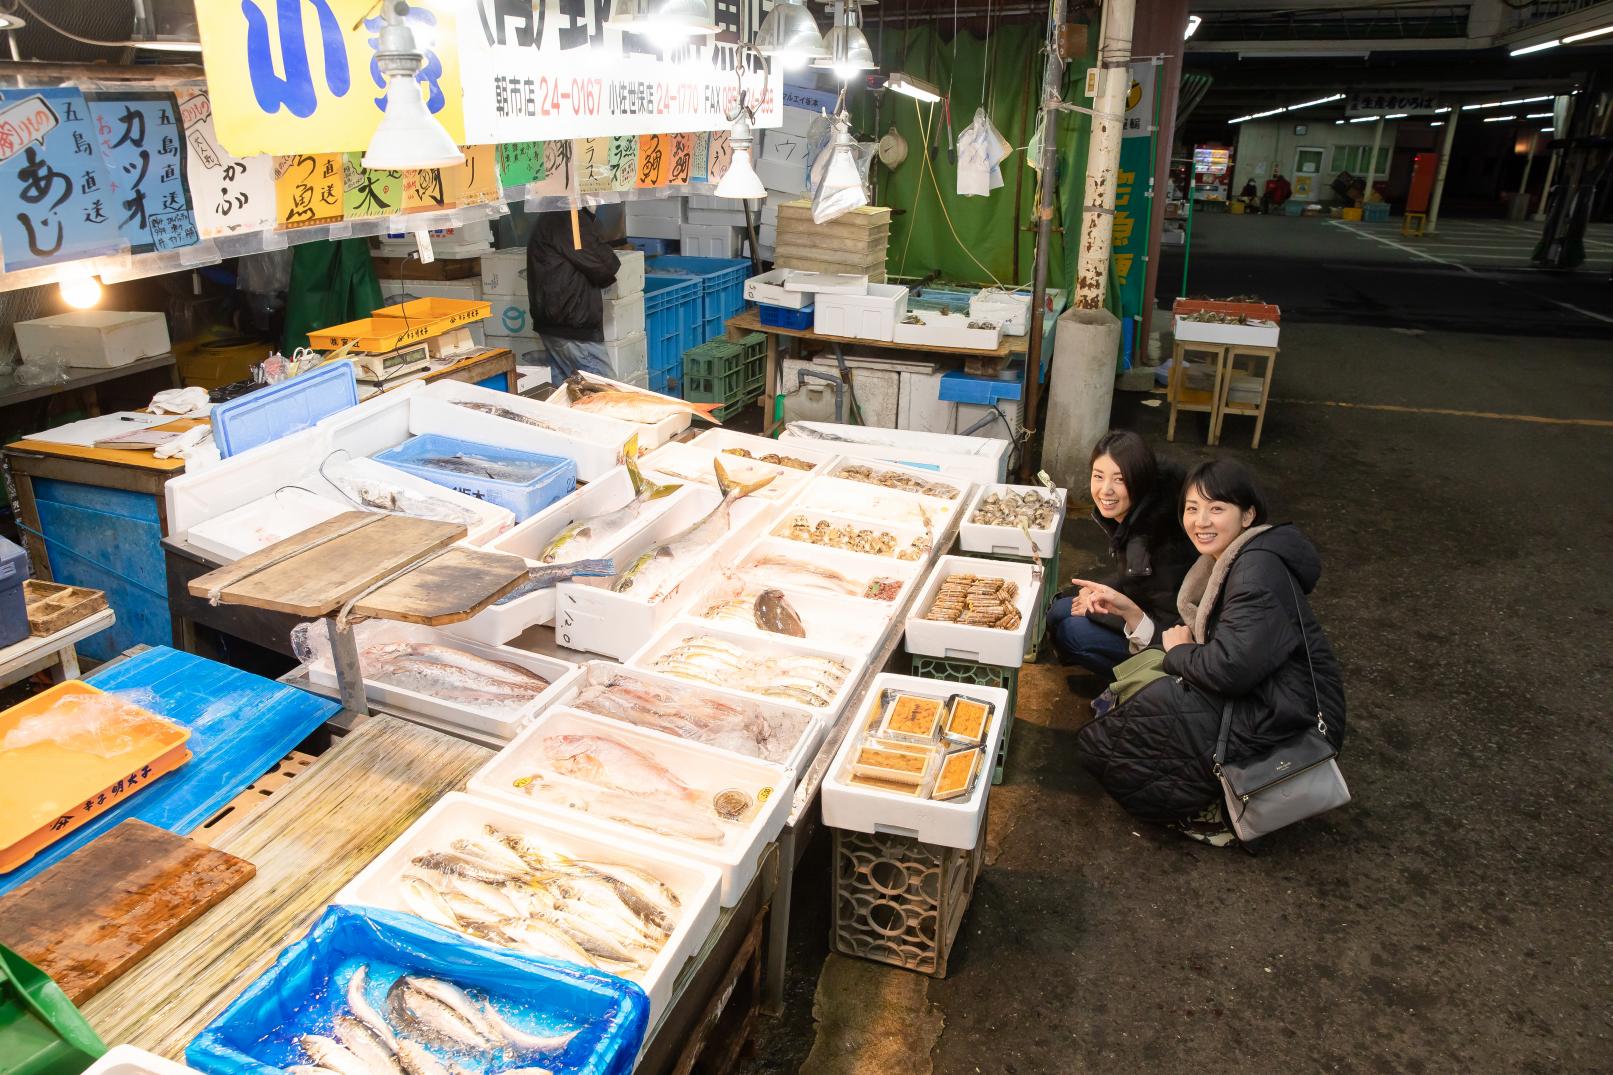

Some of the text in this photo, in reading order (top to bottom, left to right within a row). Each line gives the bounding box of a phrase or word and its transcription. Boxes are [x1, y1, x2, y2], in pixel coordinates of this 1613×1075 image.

[495, 74, 535, 117] 朝市店
[540, 76, 602, 116] 24-0167
[609, 79, 653, 115] 小佐世保店
[704, 84, 721, 114] FAX
[17, 146, 73, 257] あじ
[63, 102, 109, 224] 五島直送
[112, 105, 150, 230] カツオ
[158, 109, 185, 211] 五島直送
[216, 157, 248, 216] かぶ
